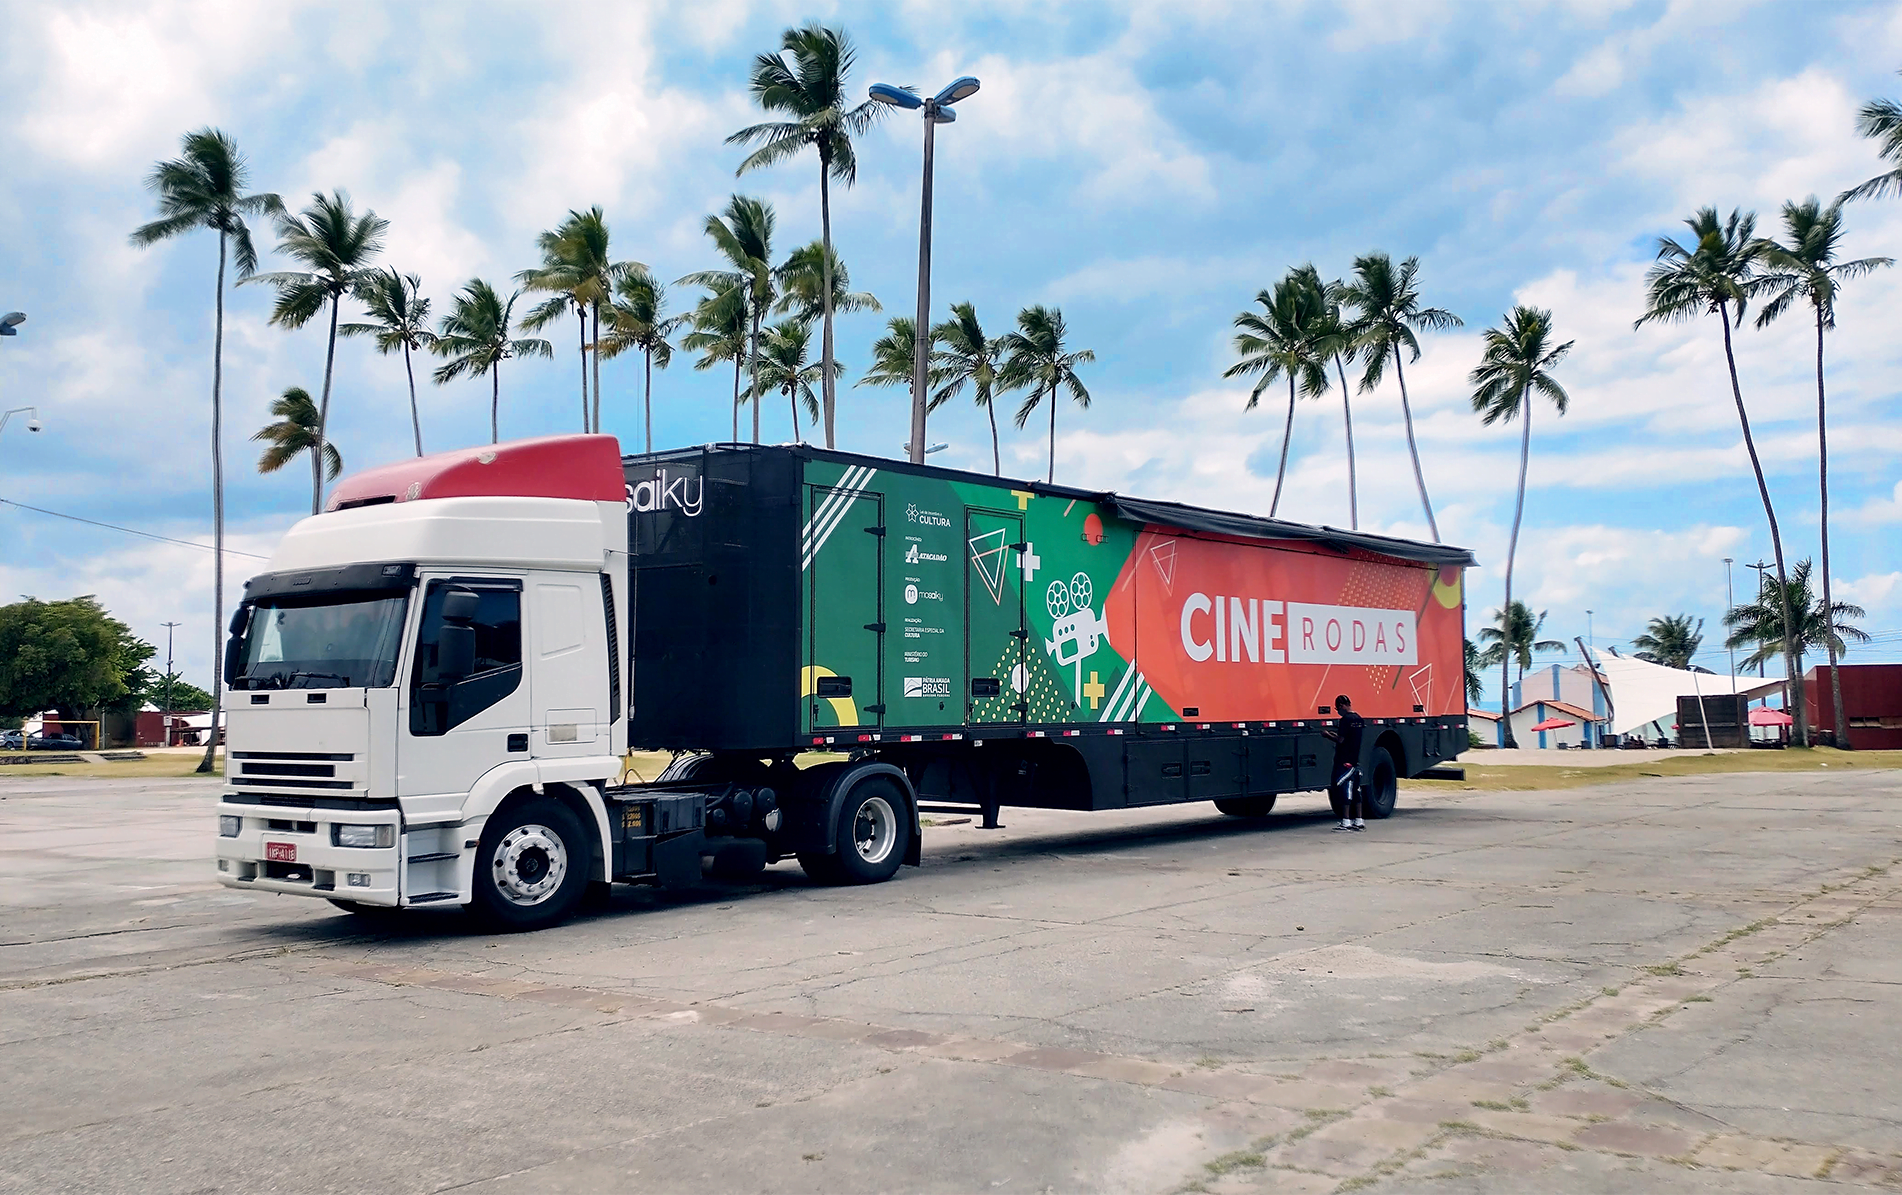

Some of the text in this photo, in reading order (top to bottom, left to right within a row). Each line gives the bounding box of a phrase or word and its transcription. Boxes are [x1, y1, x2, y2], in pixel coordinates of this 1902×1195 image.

[919, 515, 951, 527] CULTURA
[919, 591, 944, 602] mosaiky
[1180, 592, 1406, 664] CINE RODAS
[922, 683, 950, 694] BRASIL
